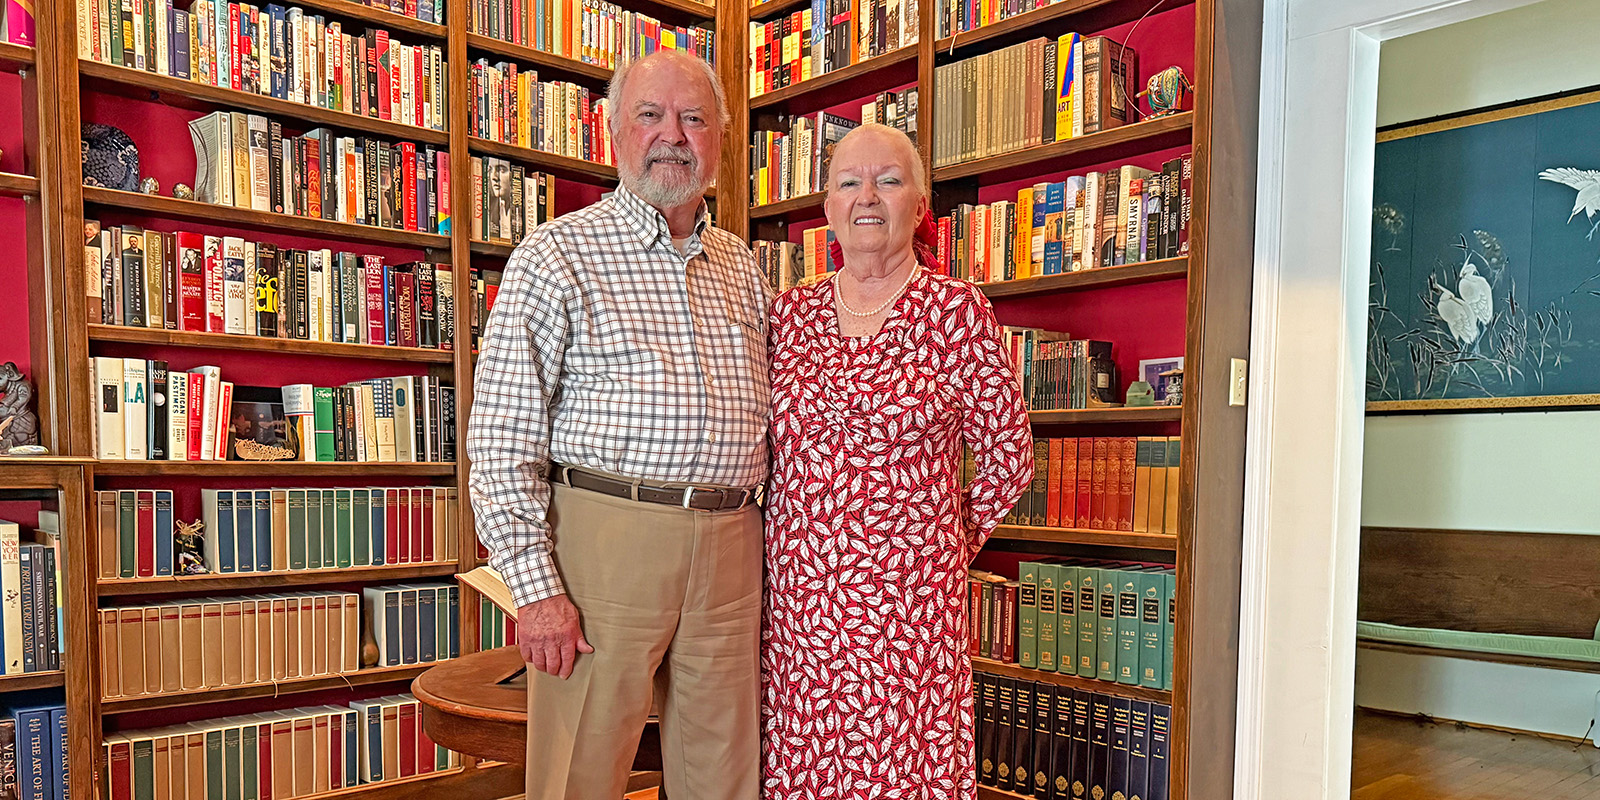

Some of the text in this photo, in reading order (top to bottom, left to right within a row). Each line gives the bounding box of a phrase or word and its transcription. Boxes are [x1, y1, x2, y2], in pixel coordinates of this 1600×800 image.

[368, 48, 376, 66] TONY
[1048, 44, 1056, 90] CIVILISATION
[392, 64, 400, 104] JULY 1903
[1057, 102, 1071, 114] ART
[271, 122, 282, 140] CHUCK
[272, 141, 282, 160] BERRY
[369, 141, 376, 150] NO
[408, 188, 416, 218] Hepburn
[472, 174, 483, 219] KEATON
[512, 178, 522, 206] AVIATORS
[1066, 197, 1075, 223] SICILY
[1128, 199, 1138, 241] SMYRNA
[91, 251, 99, 266] John
[153, 235, 161, 263] Guerrilla
[246, 250, 255, 294] CONSUELO
[312, 296, 317, 305] DU
[403, 286, 412, 340] MOUNTBATTEN
[22, 566, 32, 594] DREAM
[23, 600, 33, 630] WORLD
[24, 631, 33, 655] ANEW
[4, 743, 15, 790] VENICE
[31, 734, 42, 790] THE ART OF
[63, 772, 70, 786] OF
